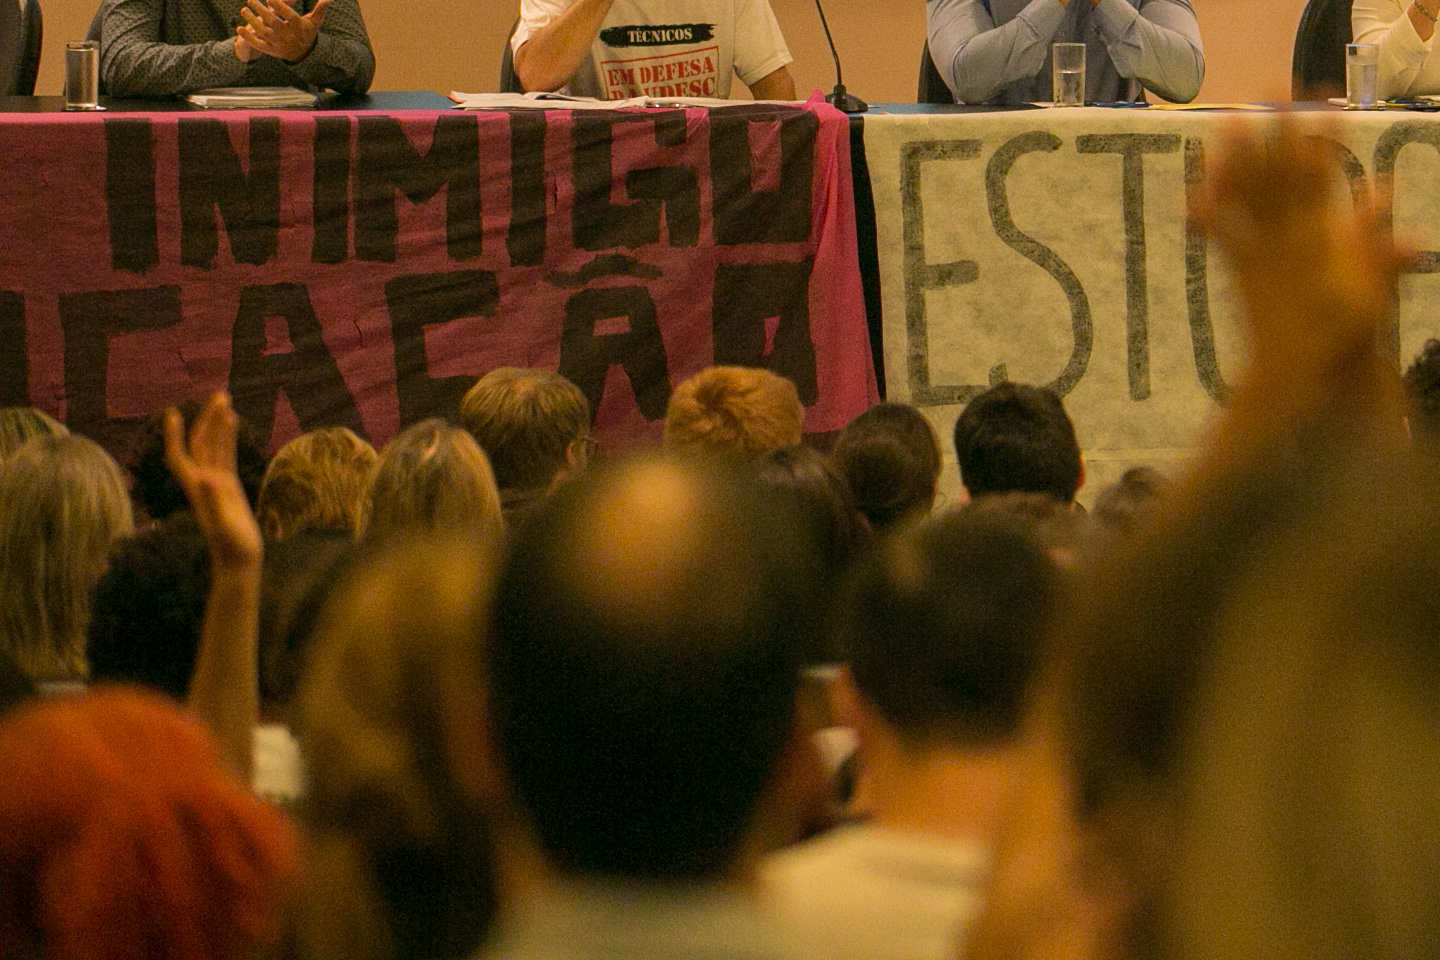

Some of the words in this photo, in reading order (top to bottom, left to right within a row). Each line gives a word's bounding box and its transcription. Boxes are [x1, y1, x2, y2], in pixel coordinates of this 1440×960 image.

[627, 27, 693, 43] TÉCNICOS
[607, 67, 636, 87] EM
[640, 56, 716, 85] DEFESA
[644, 76, 716, 98] UDESC
[103, 109, 818, 276] INIMIGO
